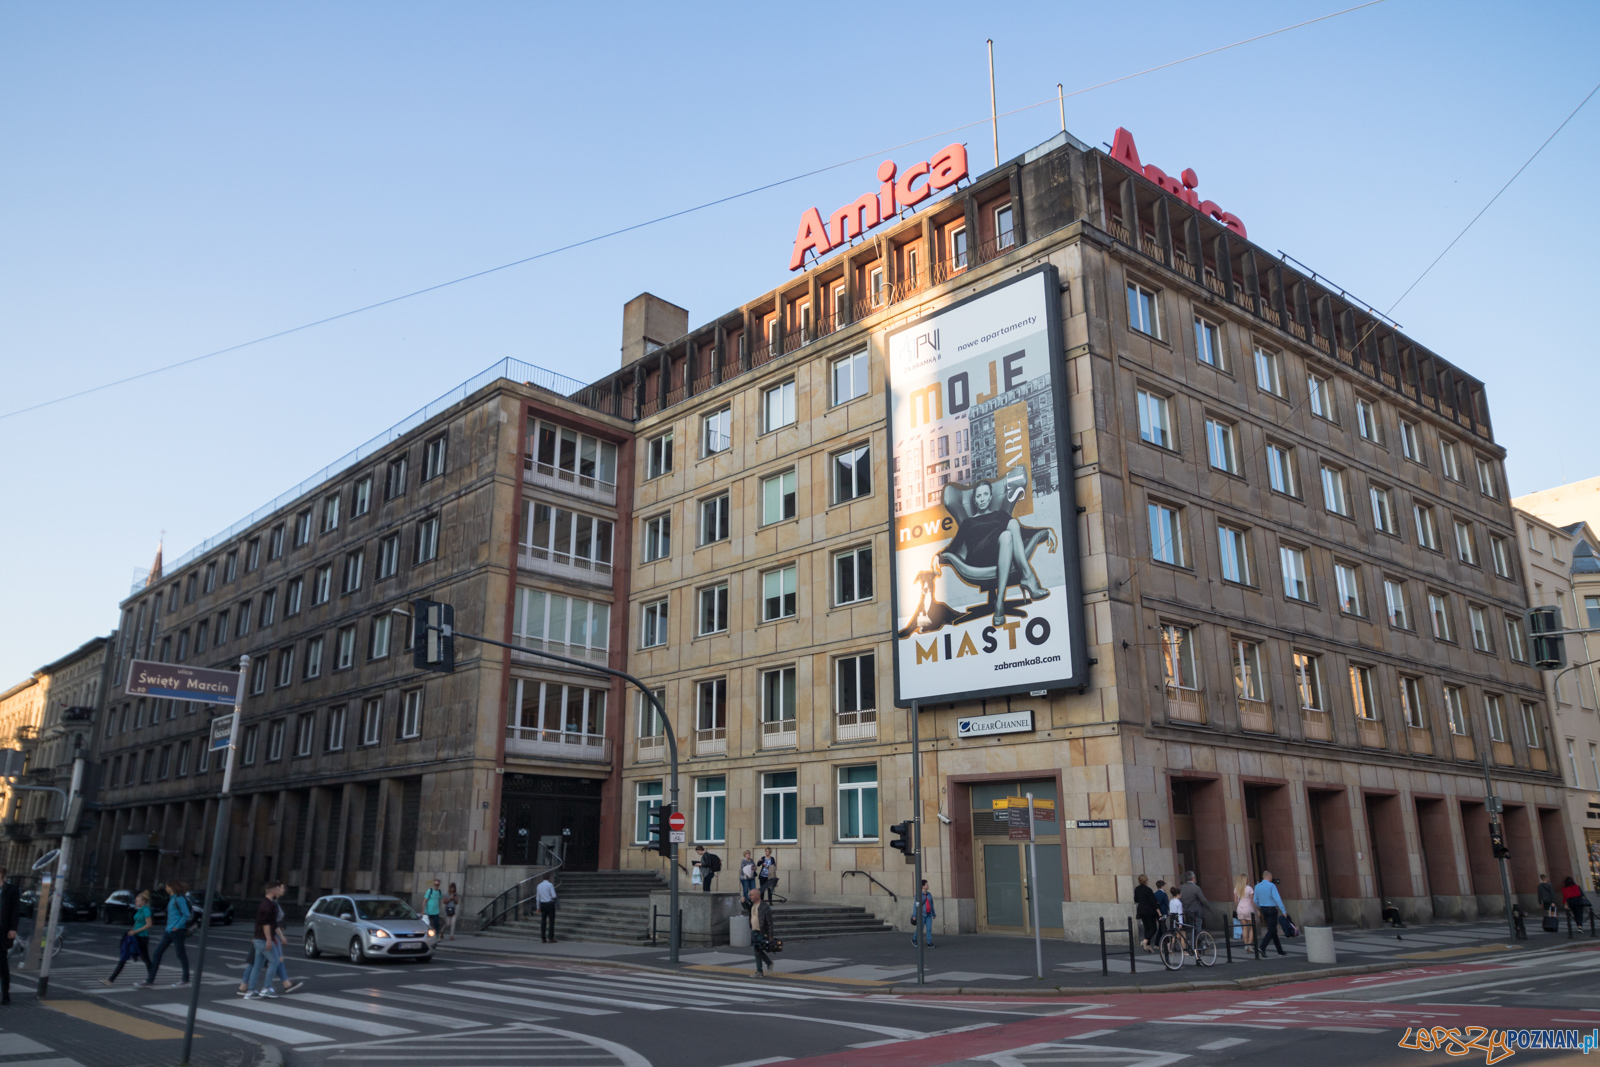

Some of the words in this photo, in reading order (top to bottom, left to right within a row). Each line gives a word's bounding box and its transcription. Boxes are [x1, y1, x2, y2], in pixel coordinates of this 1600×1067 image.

[789, 142, 968, 272] Amica
[957, 338, 979, 352] nowe
[980, 315, 1037, 345] apartamenty
[909, 349, 1027, 429] MOJE
[1003, 420, 1026, 503] STARE
[900, 516, 953, 543] nowe
[915, 616, 1051, 665] MIASTO
[138, 669, 180, 690] Święty
[186, 678, 229, 693] Marcin
[994, 654, 1061, 671] zabramka8.com
